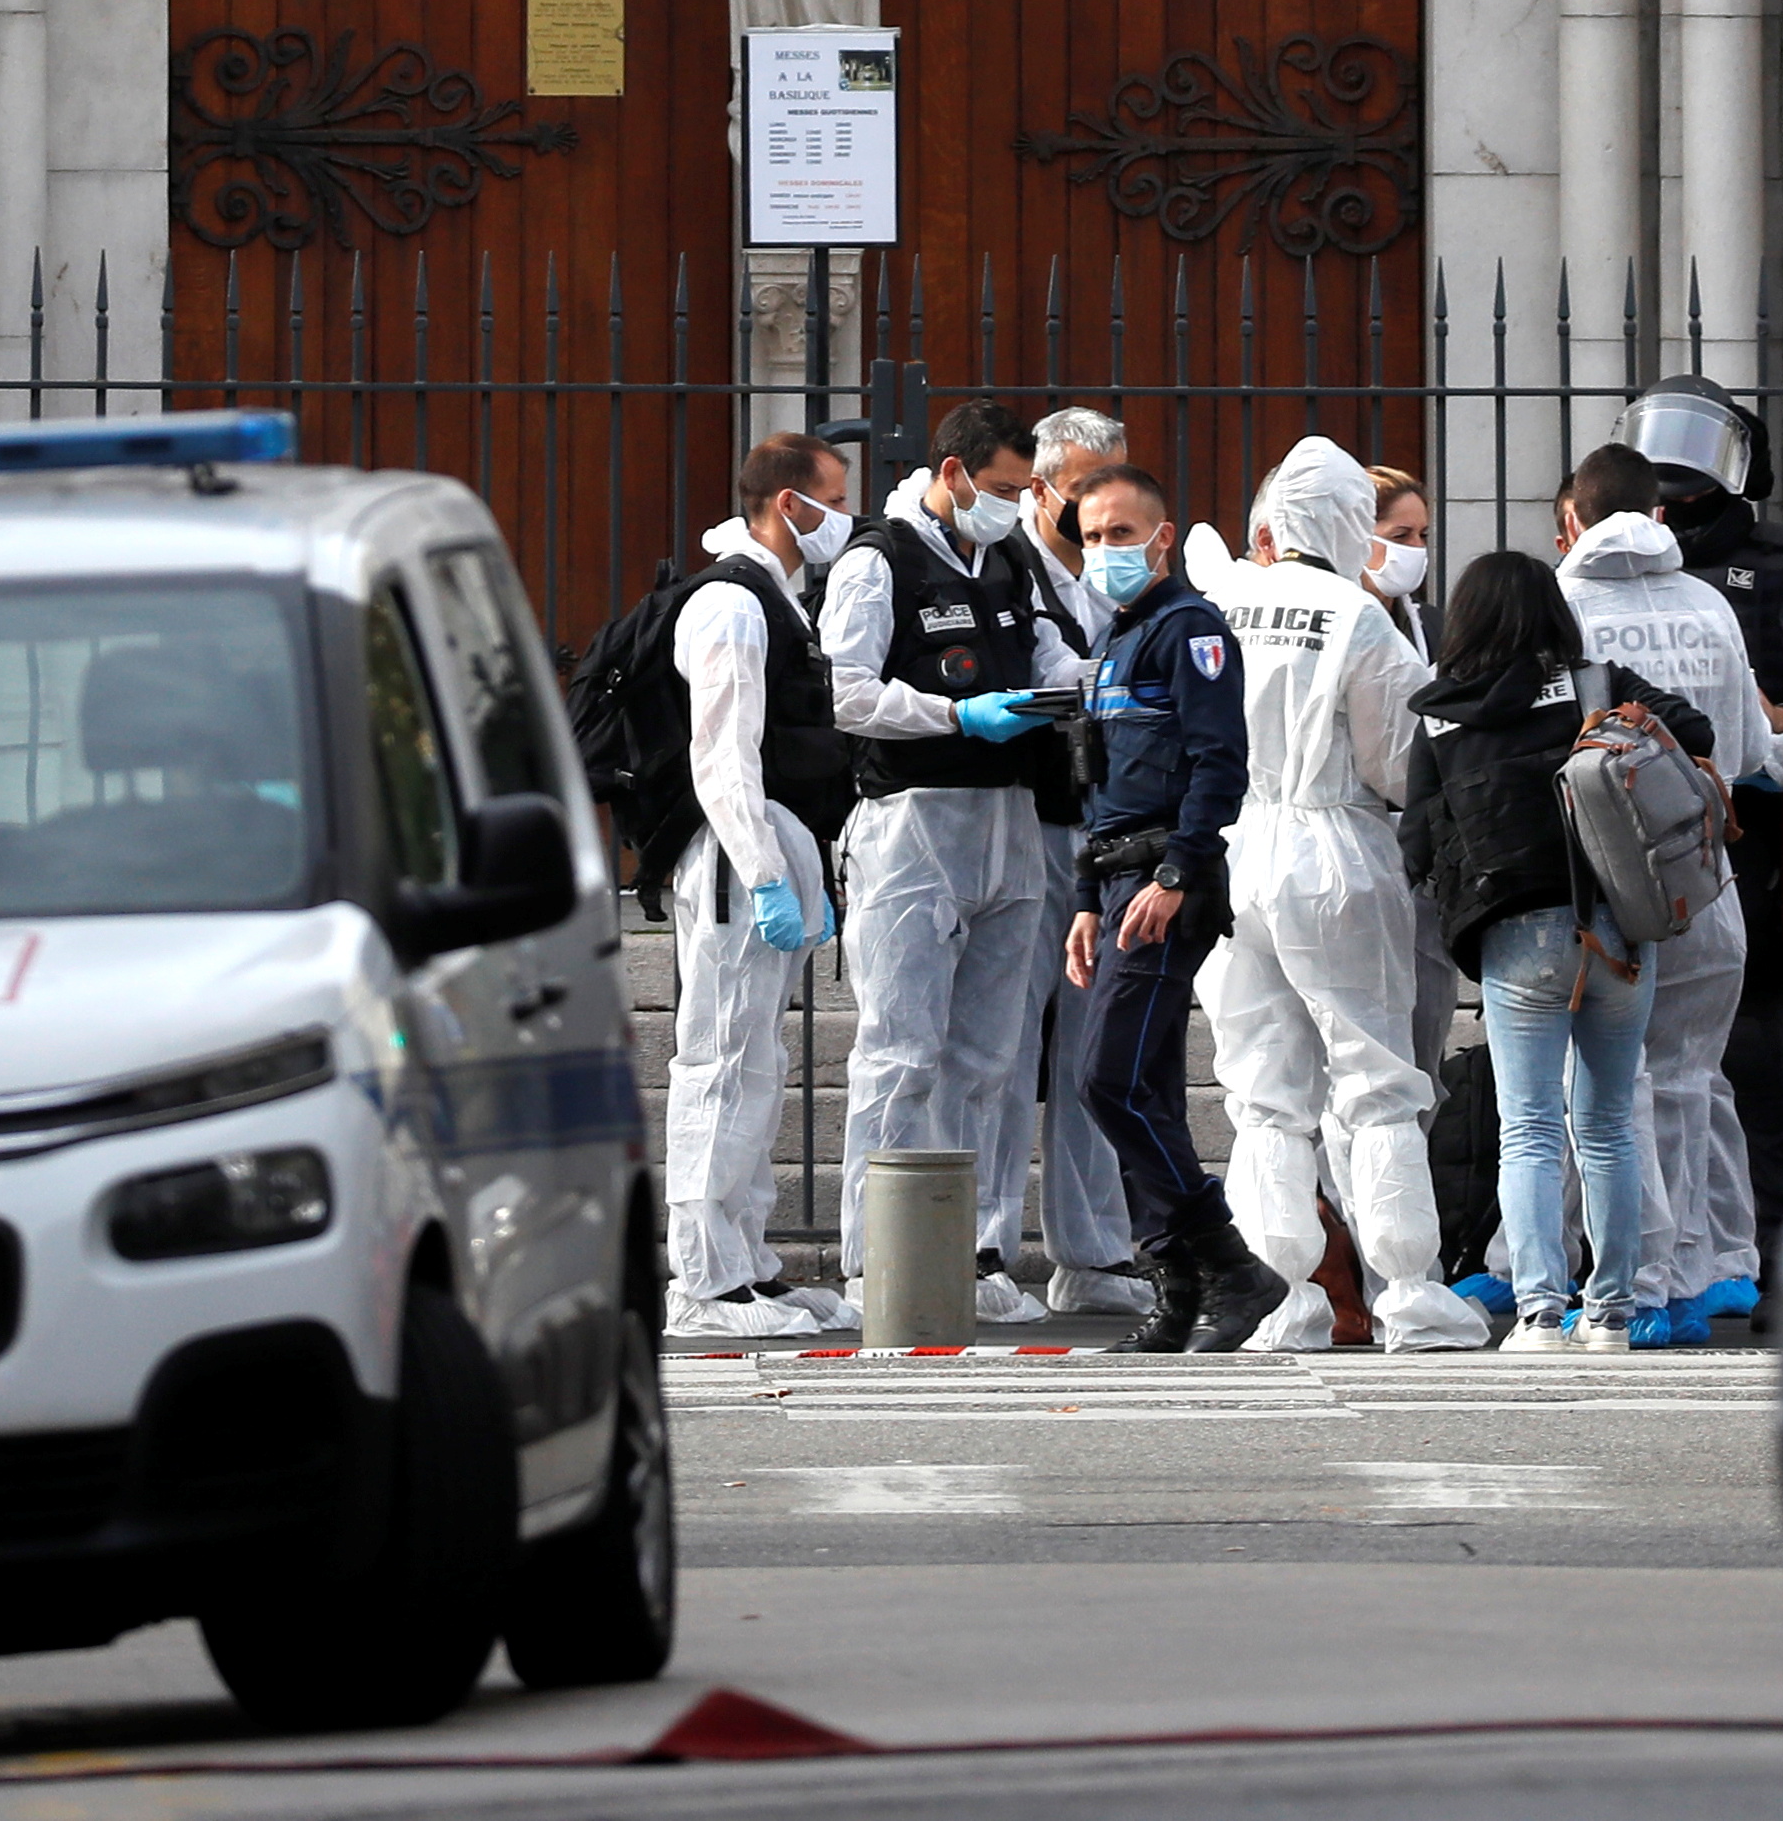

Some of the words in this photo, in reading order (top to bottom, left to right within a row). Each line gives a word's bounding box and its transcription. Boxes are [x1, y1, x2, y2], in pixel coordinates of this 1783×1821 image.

[775, 50, 820, 60] MESSES
[778, 72, 788, 81] A
[797, 72, 813, 81] LA
[769, 90, 830, 100] BASILIQUE
[1222, 607, 1336, 634] OLICE
[1594, 622, 1722, 654] POLICE
